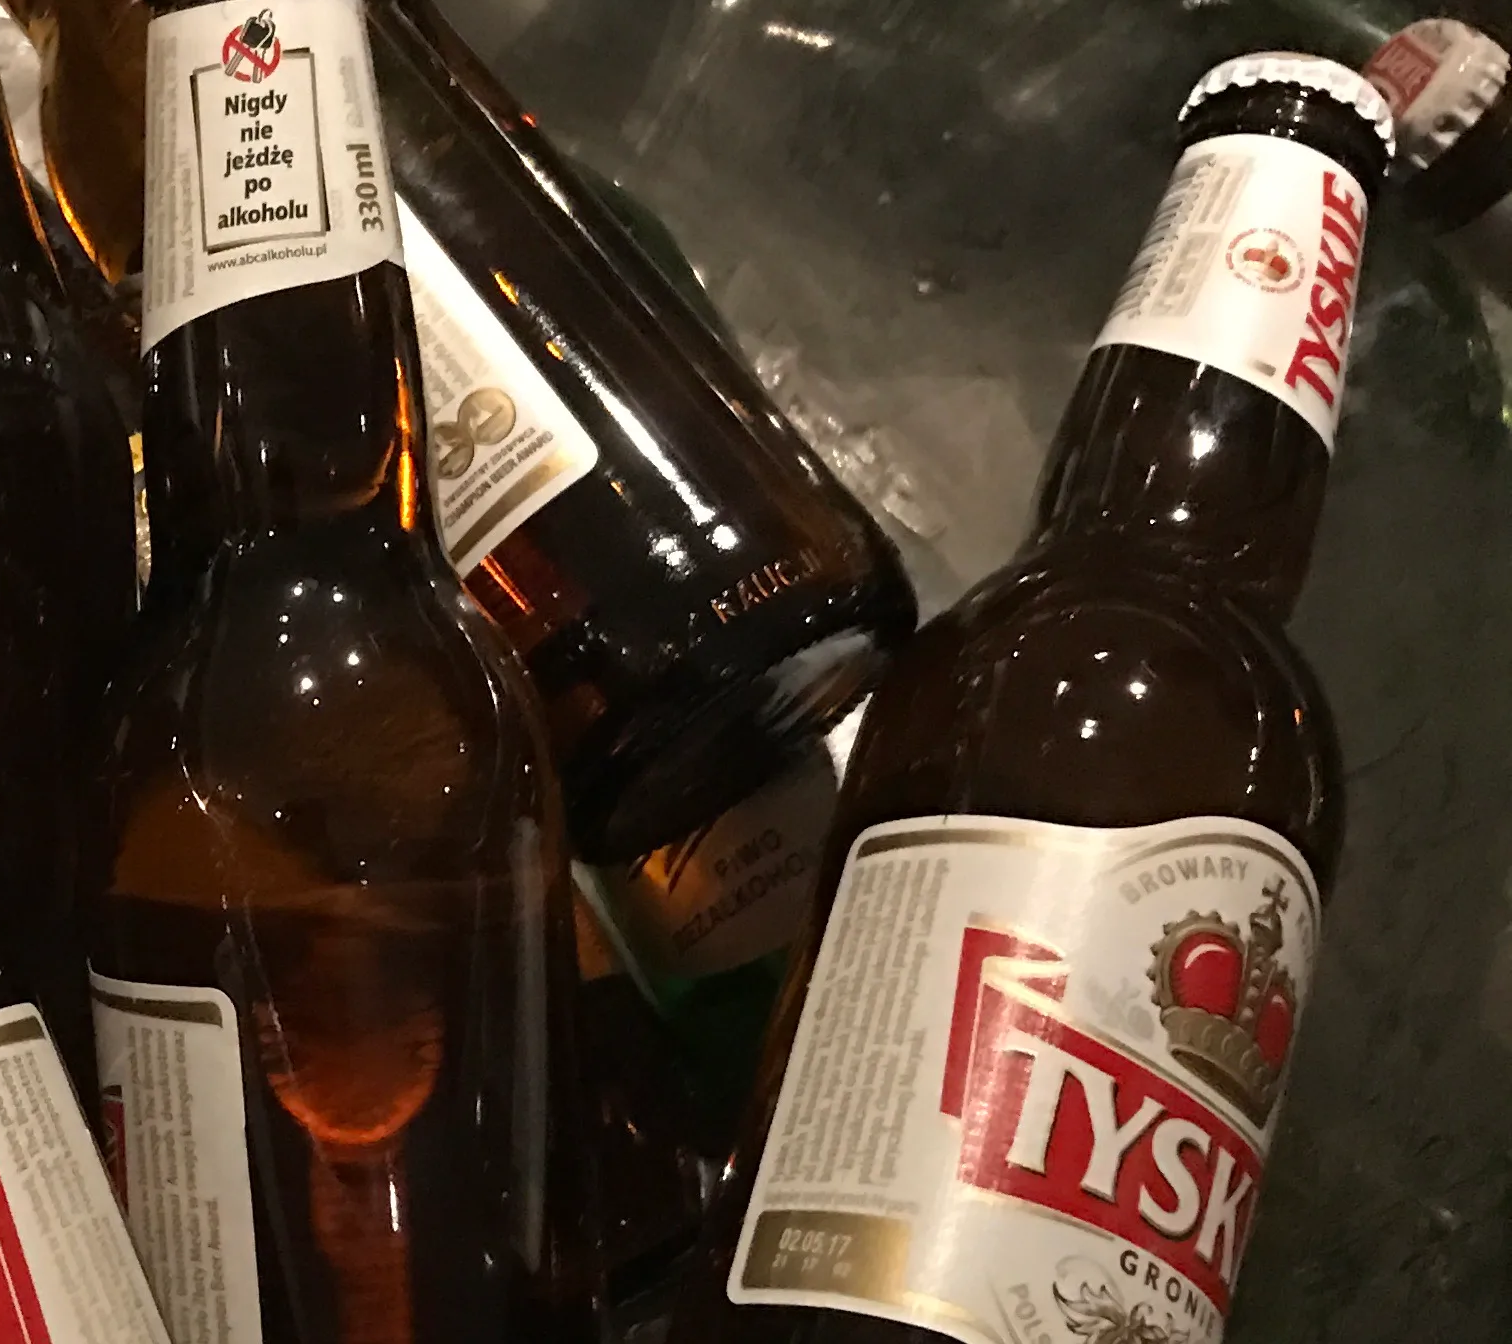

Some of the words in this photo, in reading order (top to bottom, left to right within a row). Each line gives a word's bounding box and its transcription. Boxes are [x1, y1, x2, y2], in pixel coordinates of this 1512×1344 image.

[224, 90, 288, 117] Nigdy
[240, 122, 273, 144] nie
[224, 147, 294, 178] jeżdżę
[244, 176, 273, 200] po
[217, 199, 309, 230] alkoholu
[206, 244, 329, 273] www.abcalkoholu.pl
[1284, 171, 1366, 408] TYSKIE
[1119, 855, 1250, 905] BROWARY
